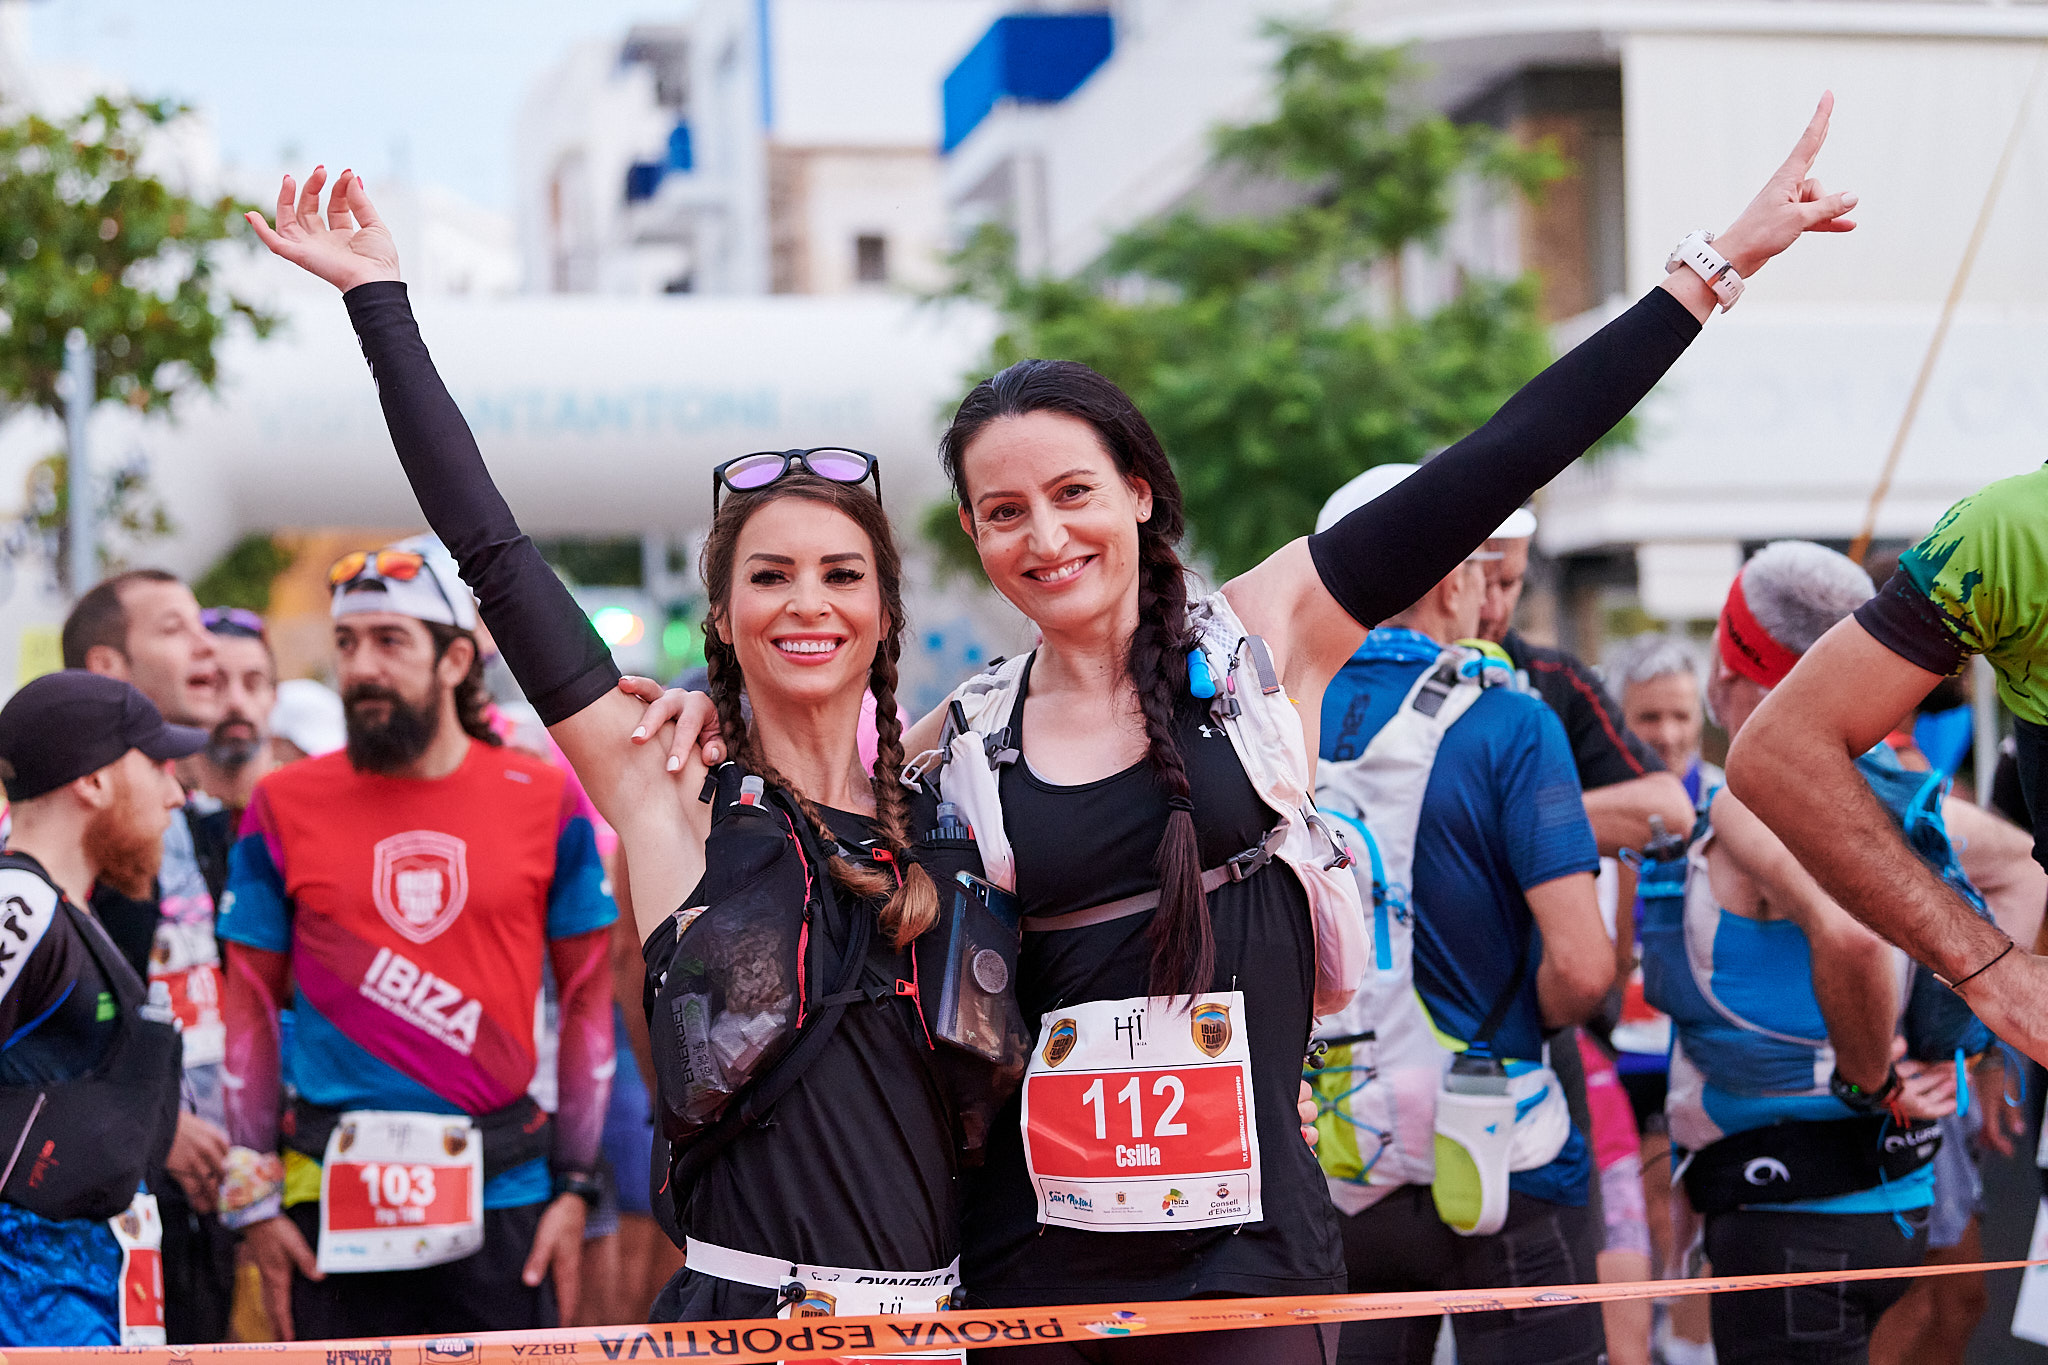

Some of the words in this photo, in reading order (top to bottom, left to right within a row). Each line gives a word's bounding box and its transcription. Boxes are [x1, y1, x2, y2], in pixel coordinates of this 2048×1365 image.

[364, 946, 483, 1046] IBIZA
[1201, 1024, 1222, 1035] IBIZA
[1202, 1033, 1223, 1044] TRAIL
[1082, 1075, 1188, 1140] 112
[1115, 1144, 1161, 1168] Csilla
[359, 1162, 437, 1207] 103
[1210, 1198, 1239, 1208] Consell
[593, 1323, 876, 1360] ESPORTIVA
[888, 1317, 1065, 1346] PROVA
[435, 1343, 468, 1352] IBIZA
[512, 1343, 579, 1356] IBIZA
